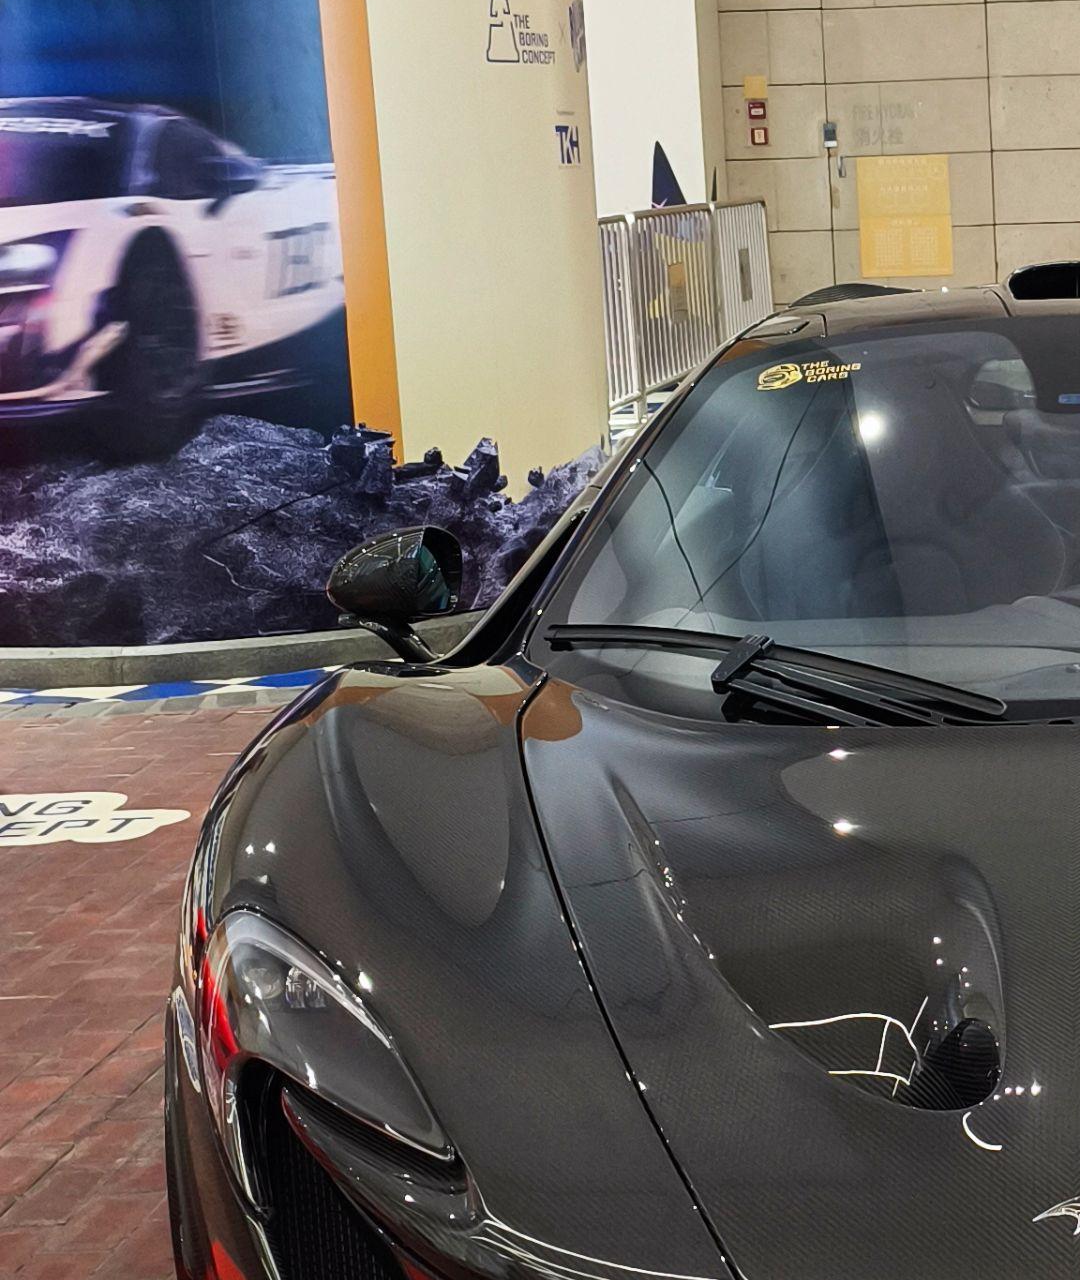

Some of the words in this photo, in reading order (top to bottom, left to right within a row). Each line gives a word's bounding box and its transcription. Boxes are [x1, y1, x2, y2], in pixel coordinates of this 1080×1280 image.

[513, 14, 531, 29] THE
[519, 32, 549, 46] BORING
[521, 50, 556, 65] CONCEPT
[801, 360, 830, 371] THE
[804, 362, 862, 377] BORING
